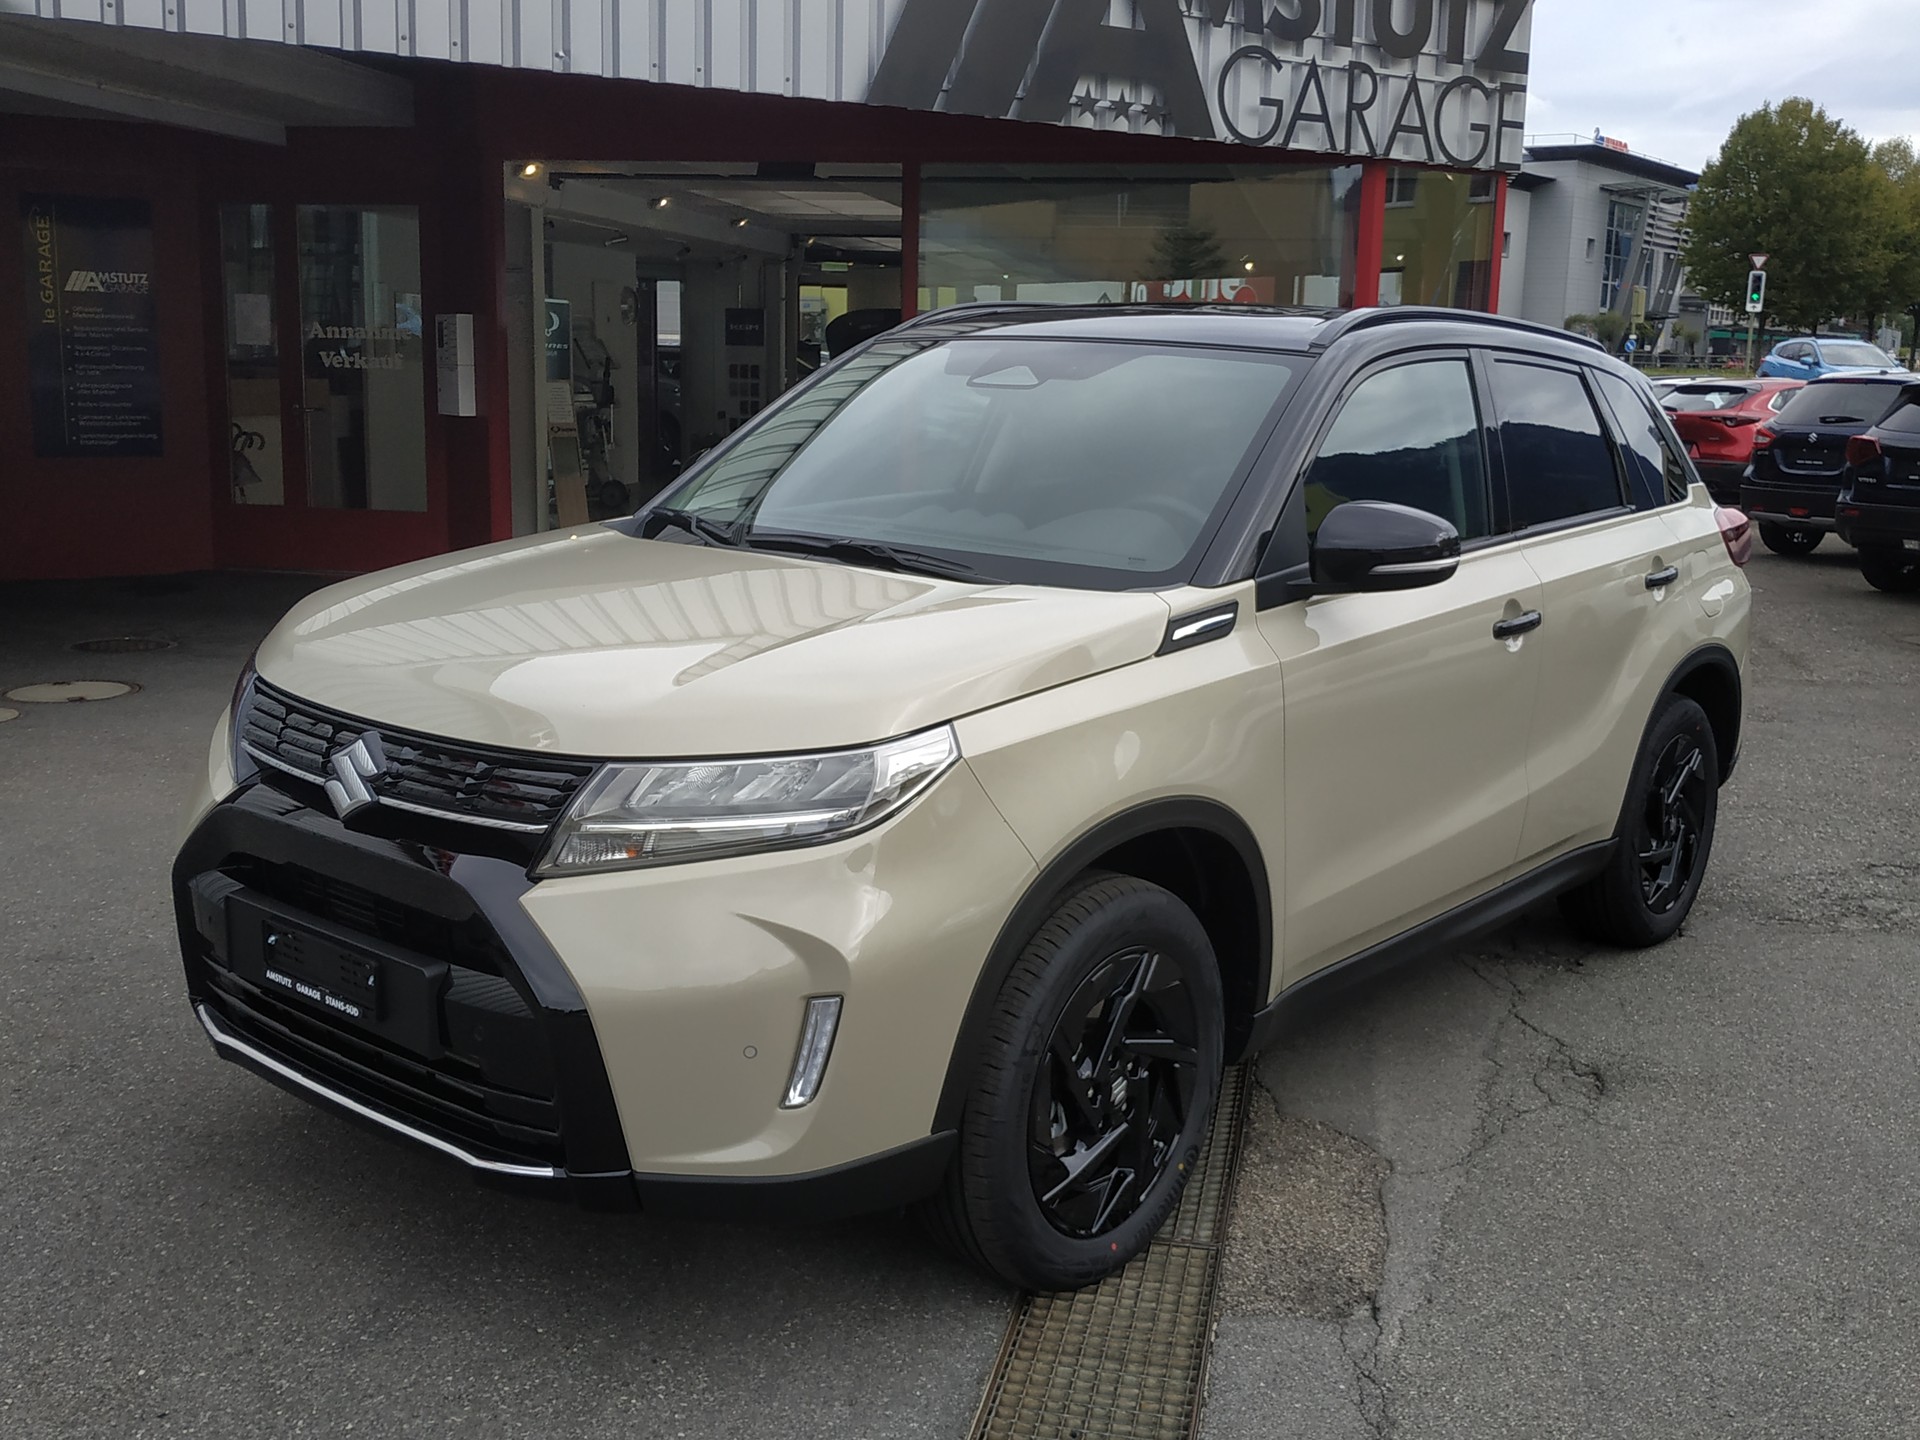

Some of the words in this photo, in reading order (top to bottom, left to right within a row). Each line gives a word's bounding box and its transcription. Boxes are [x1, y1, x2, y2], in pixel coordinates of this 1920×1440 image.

[1217, 45, 1527, 171] GARAGE
[35, 215, 55, 304] GARAGE
[309, 321, 412, 340] Annahme
[318, 350, 404, 369] Verkauf
[266, 969, 293, 989] AMSTUTZ
[296, 982, 321, 1001] GARAGE
